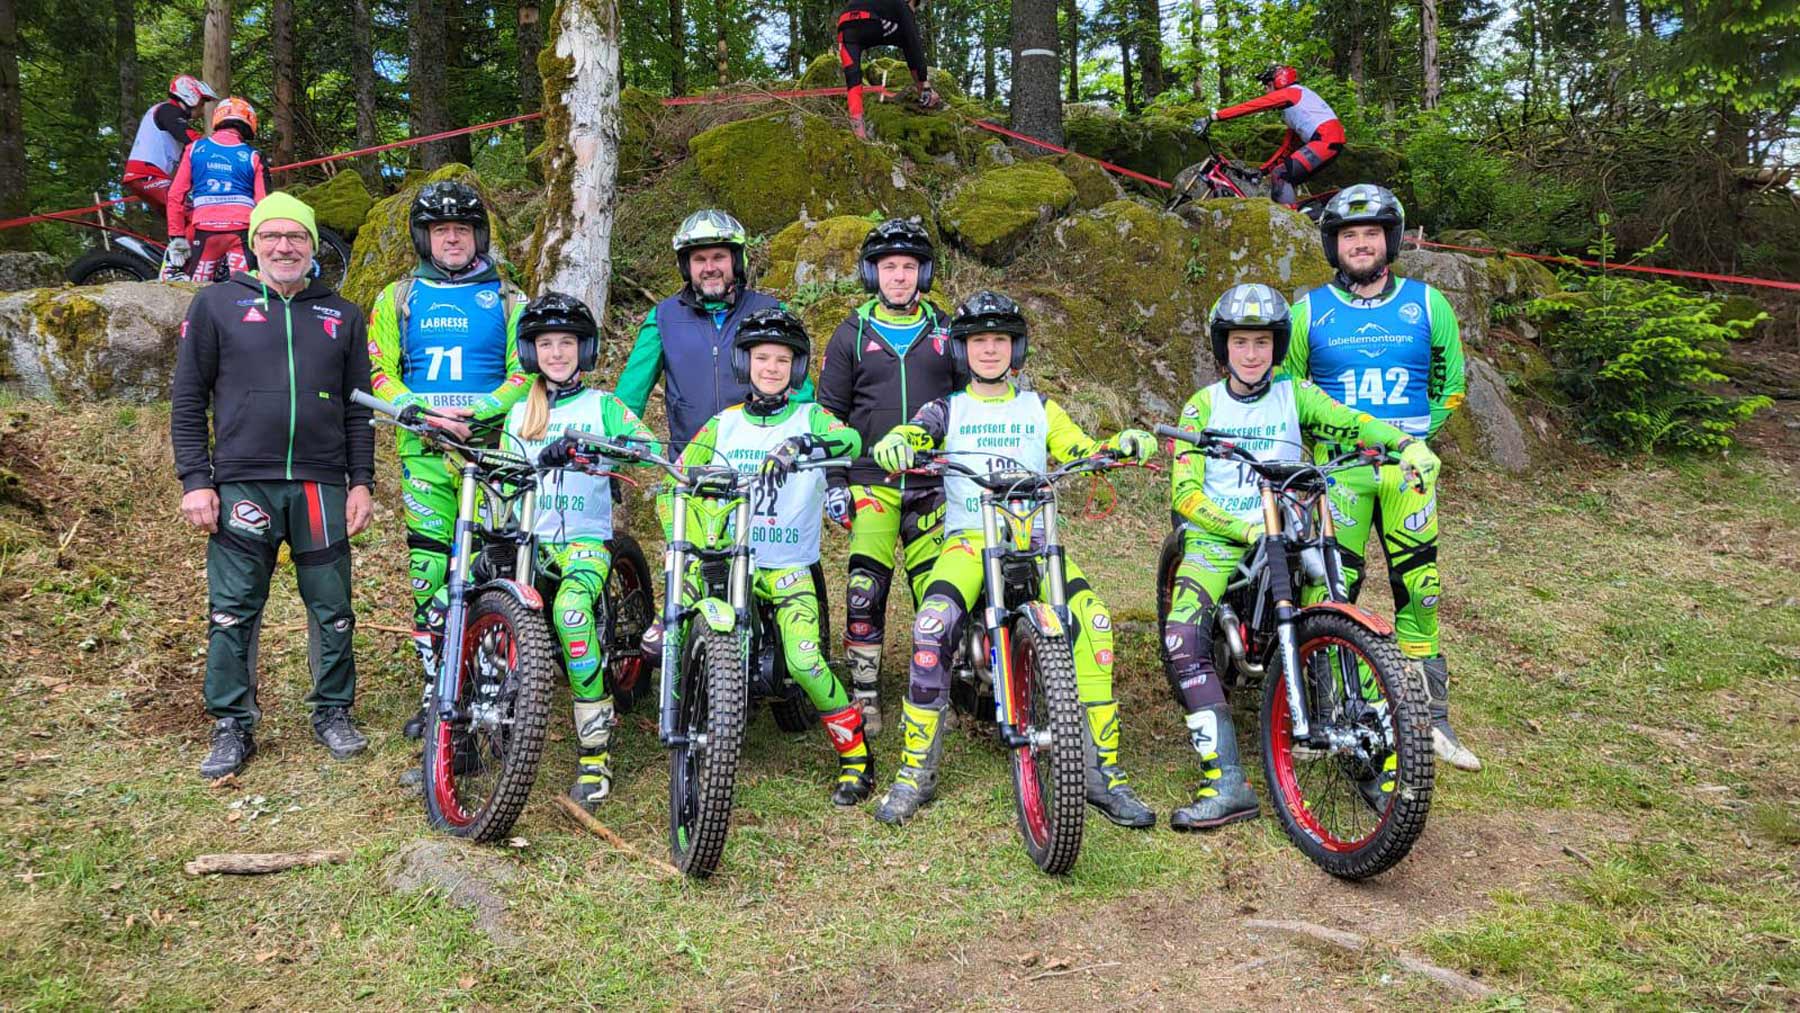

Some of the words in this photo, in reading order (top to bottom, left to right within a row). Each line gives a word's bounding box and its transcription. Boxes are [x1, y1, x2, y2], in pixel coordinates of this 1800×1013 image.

[420, 317, 469, 329] LABRESSE
[1328, 334, 1414, 347] labellemontagne
[425, 345, 463, 381] 71
[1337, 366, 1410, 406] 142
[433, 395, 474, 407] BRESSE
[959, 424, 1006, 435] BRASSERIE
[1010, 424, 1021, 434] DE
[1025, 424, 1035, 434] LA
[1265, 425, 1277, 435] DE
[977, 437, 1021, 448] SCHLUCHT
[572, 496, 585, 511] 26
[966, 497, 979, 512] 03
[752, 526, 766, 542] 60
[769, 527, 783, 543] 08
[785, 528, 799, 544] 26
